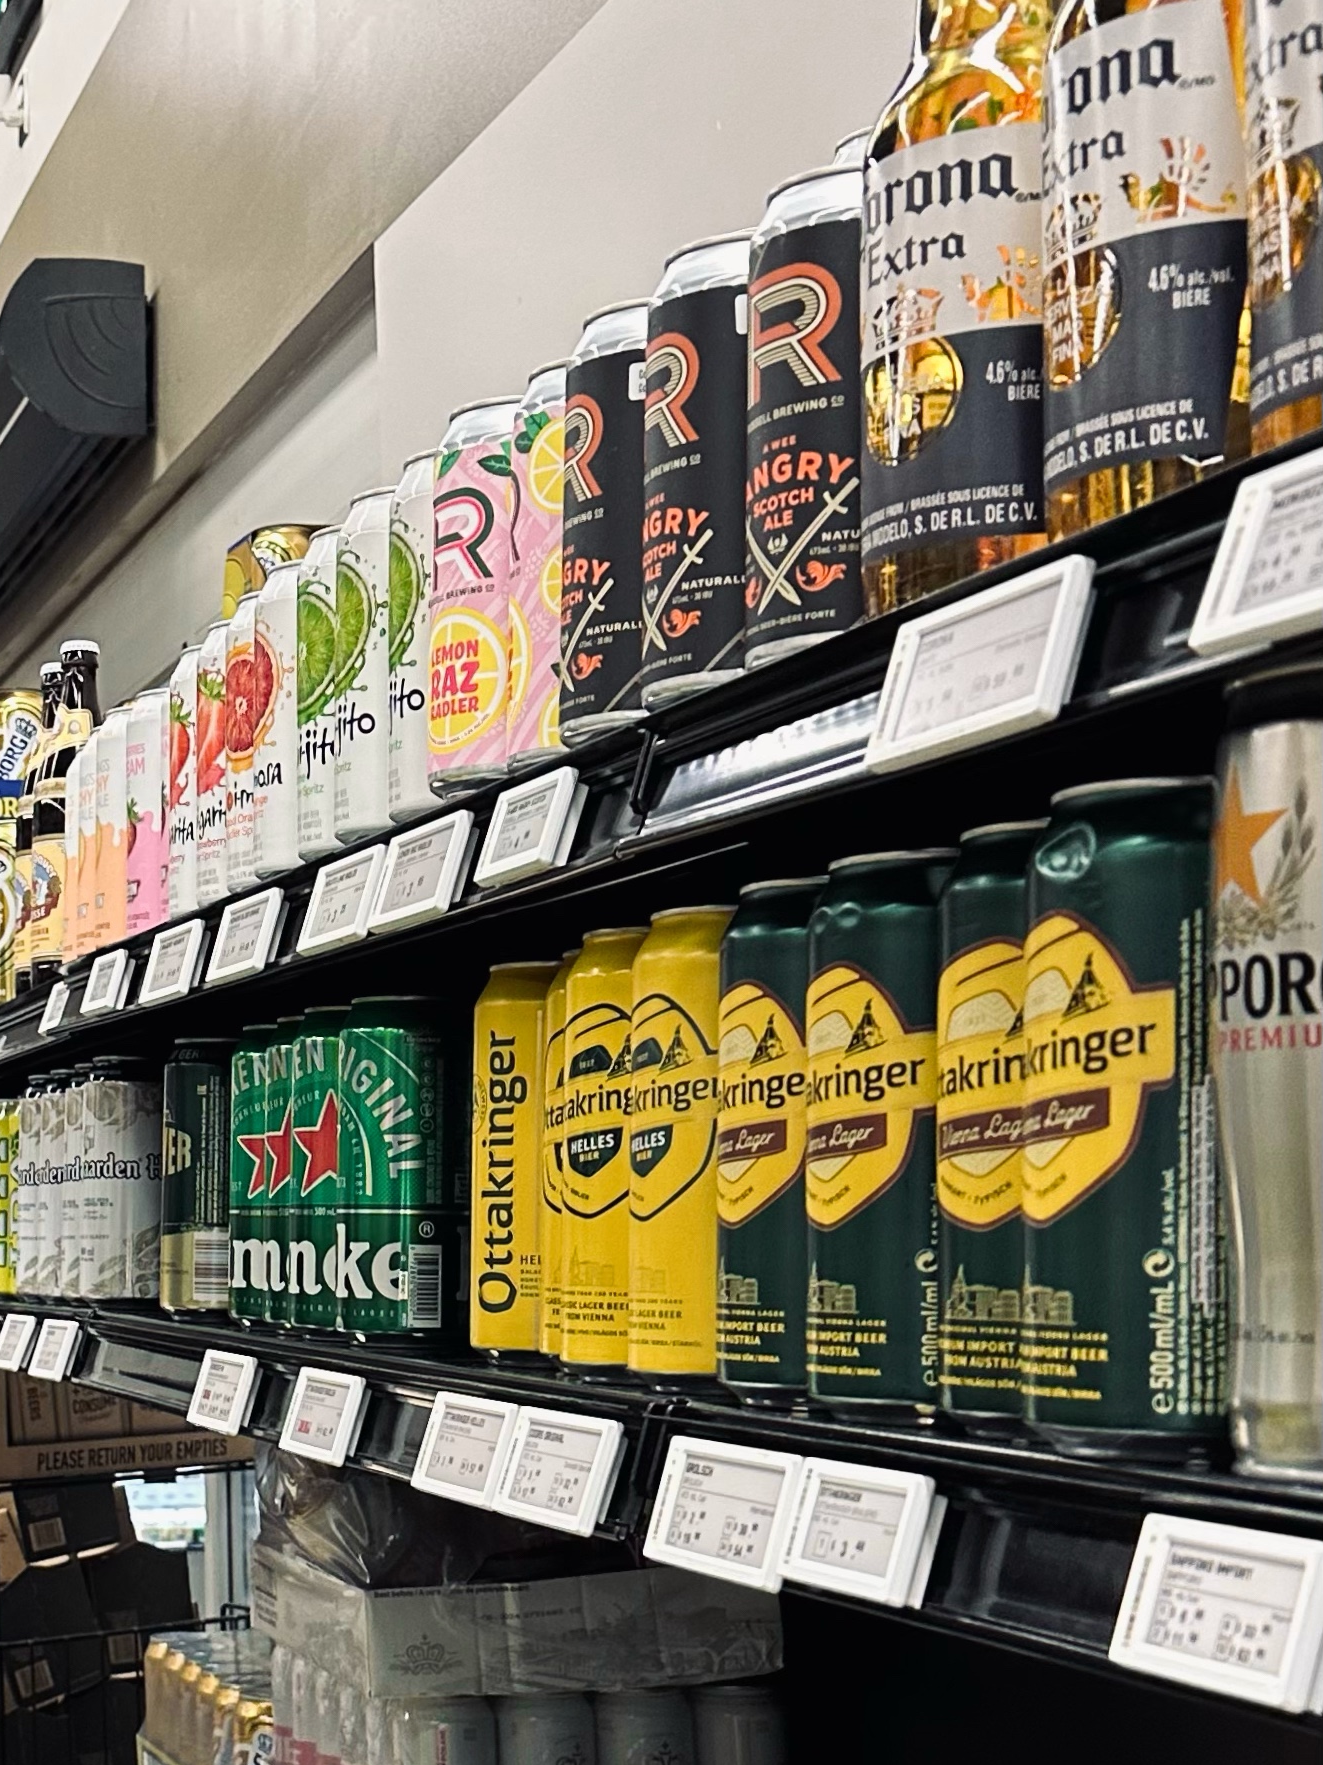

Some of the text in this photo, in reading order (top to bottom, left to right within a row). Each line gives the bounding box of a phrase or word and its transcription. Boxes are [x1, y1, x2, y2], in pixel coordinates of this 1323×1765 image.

[1147, 263, 1184, 293] 4.6%
[985, 360, 1017, 386] 4.6%
[772, 396, 827, 421] BREWING
[1136, 401, 1176, 420] LICENCE
[1179, 398, 1194, 413] DE
[1094, 435, 1112, 459] DE
[1115, 428, 1146, 452] R.L.
[1149, 421, 1173, 446] DE
[1176, 417, 1210, 443] C.V.
[1012, 482, 1025, 497] DE
[753, 486, 814, 519] SCOTCH
[763, 509, 794, 533] ALE
[930, 510, 948, 532] DE
[951, 506, 981, 528] R.L.
[985, 503, 1006, 525] DE
[1009, 502, 1038, 522] C.V.
[431, 661, 480, 704] RAZ
[1043, 1100, 1095, 1130] Lager
[570, 1132, 615, 1155] HELLES
[735, 1128, 776, 1153] Lager
[828, 1123, 875, 1150] Lager
[579, 1150, 601, 1163] BIER
[477, 1030, 528, 1314] Ottakringer
[756, 1321, 786, 1333] BEER
[854, 1332, 887, 1344] BEER
[966, 1340, 1014, 1354] IMPORT
[37, 1437, 227, 1472] PLEASE RETURN YOUR EMPTIES
